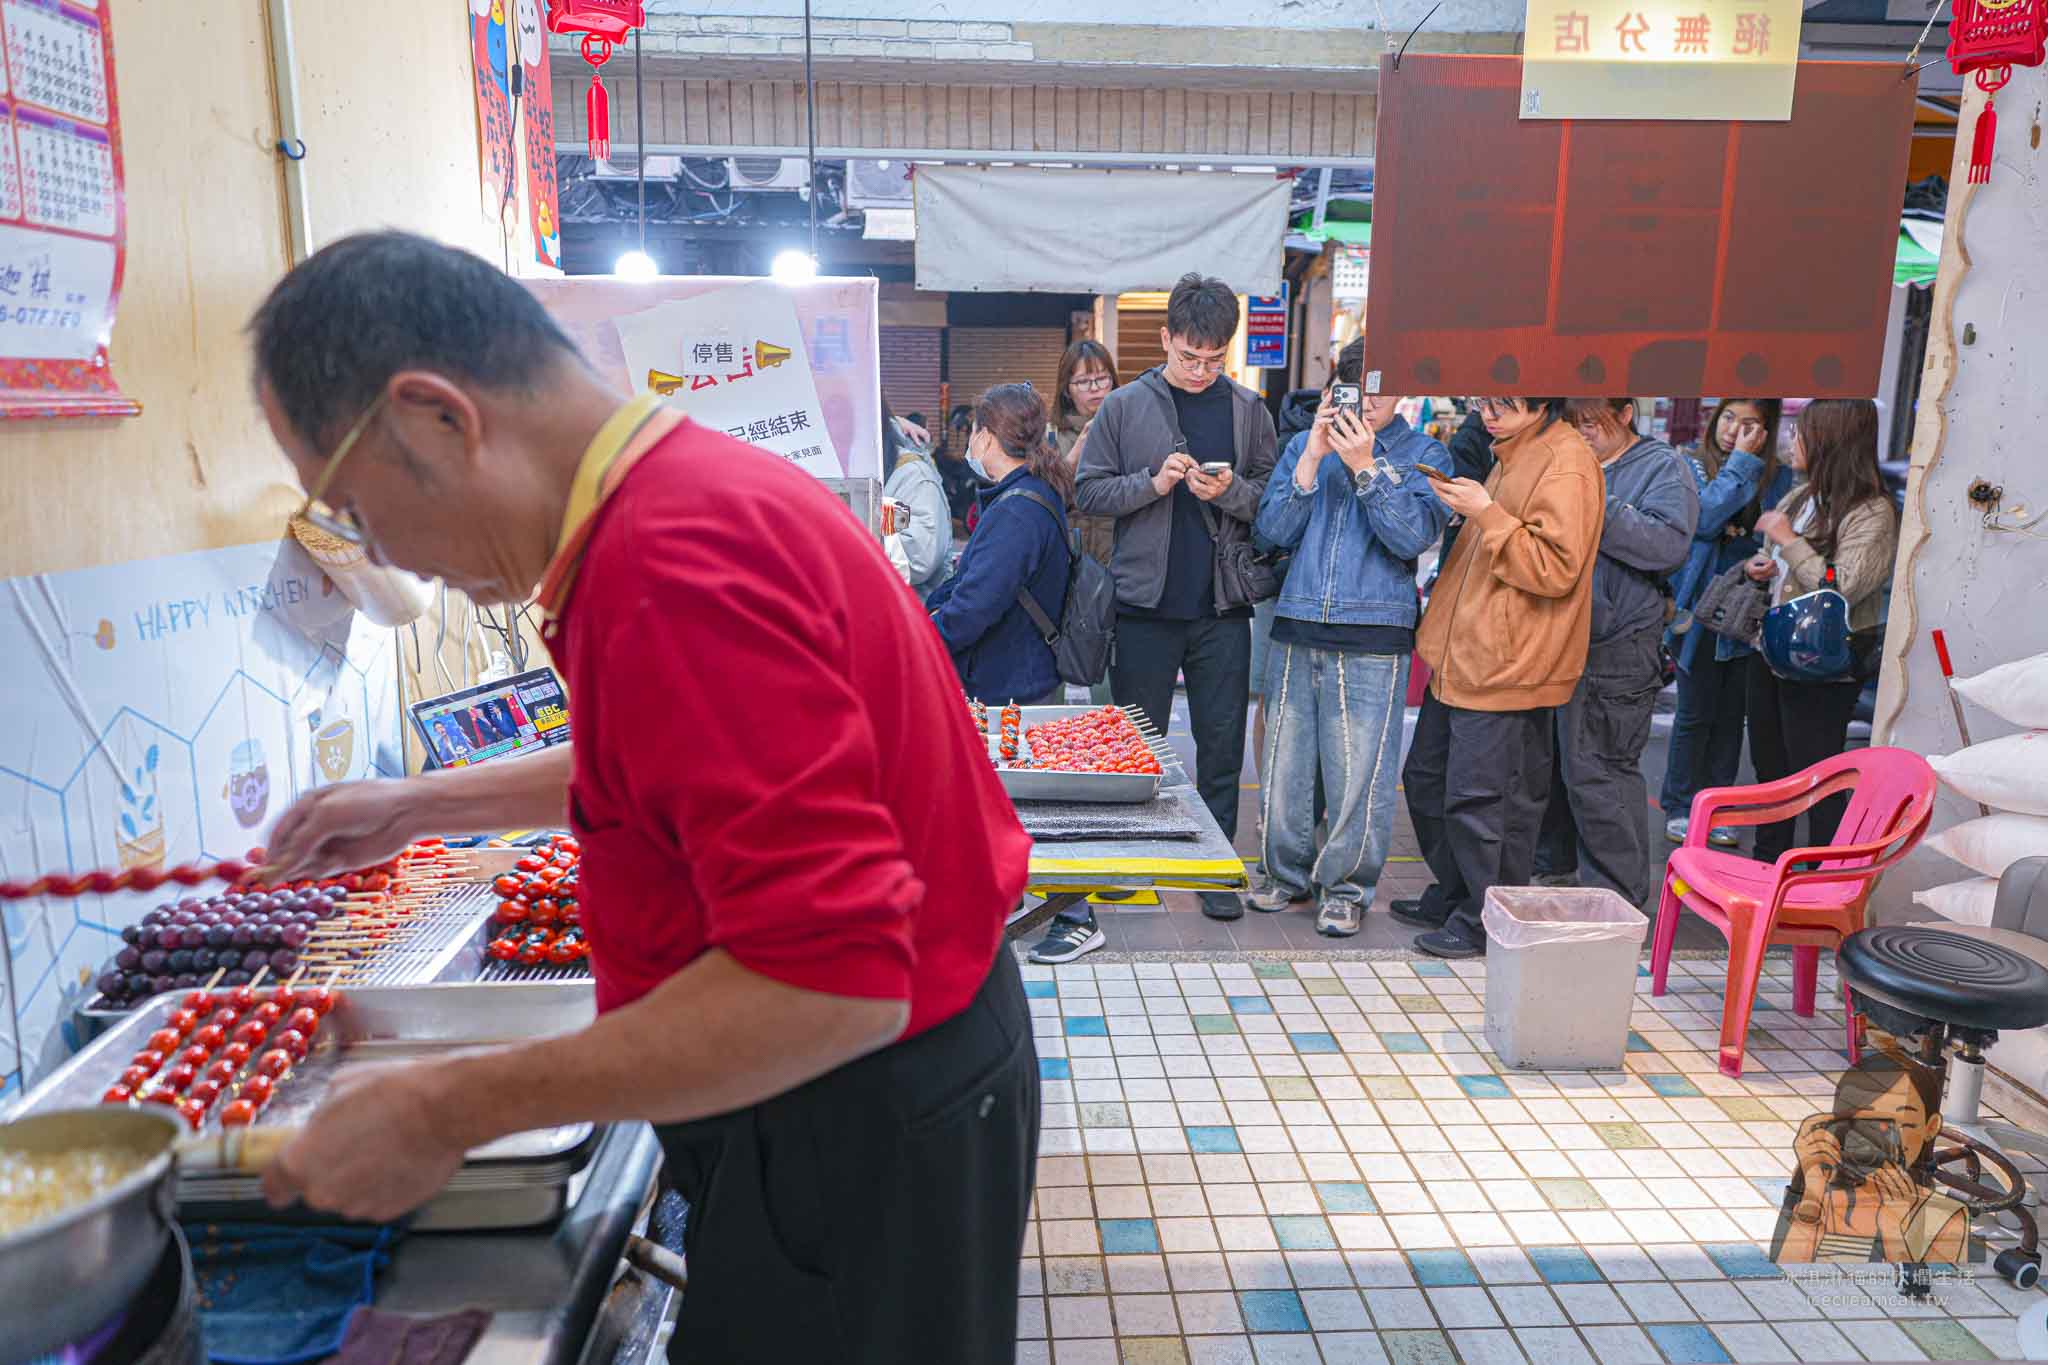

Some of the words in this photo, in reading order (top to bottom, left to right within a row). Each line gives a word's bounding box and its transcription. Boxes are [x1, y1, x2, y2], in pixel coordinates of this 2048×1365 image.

[693, 343, 733, 363] 停售
[134, 592, 211, 640] HAPPY
[223, 578, 310, 617] KITCHEN
